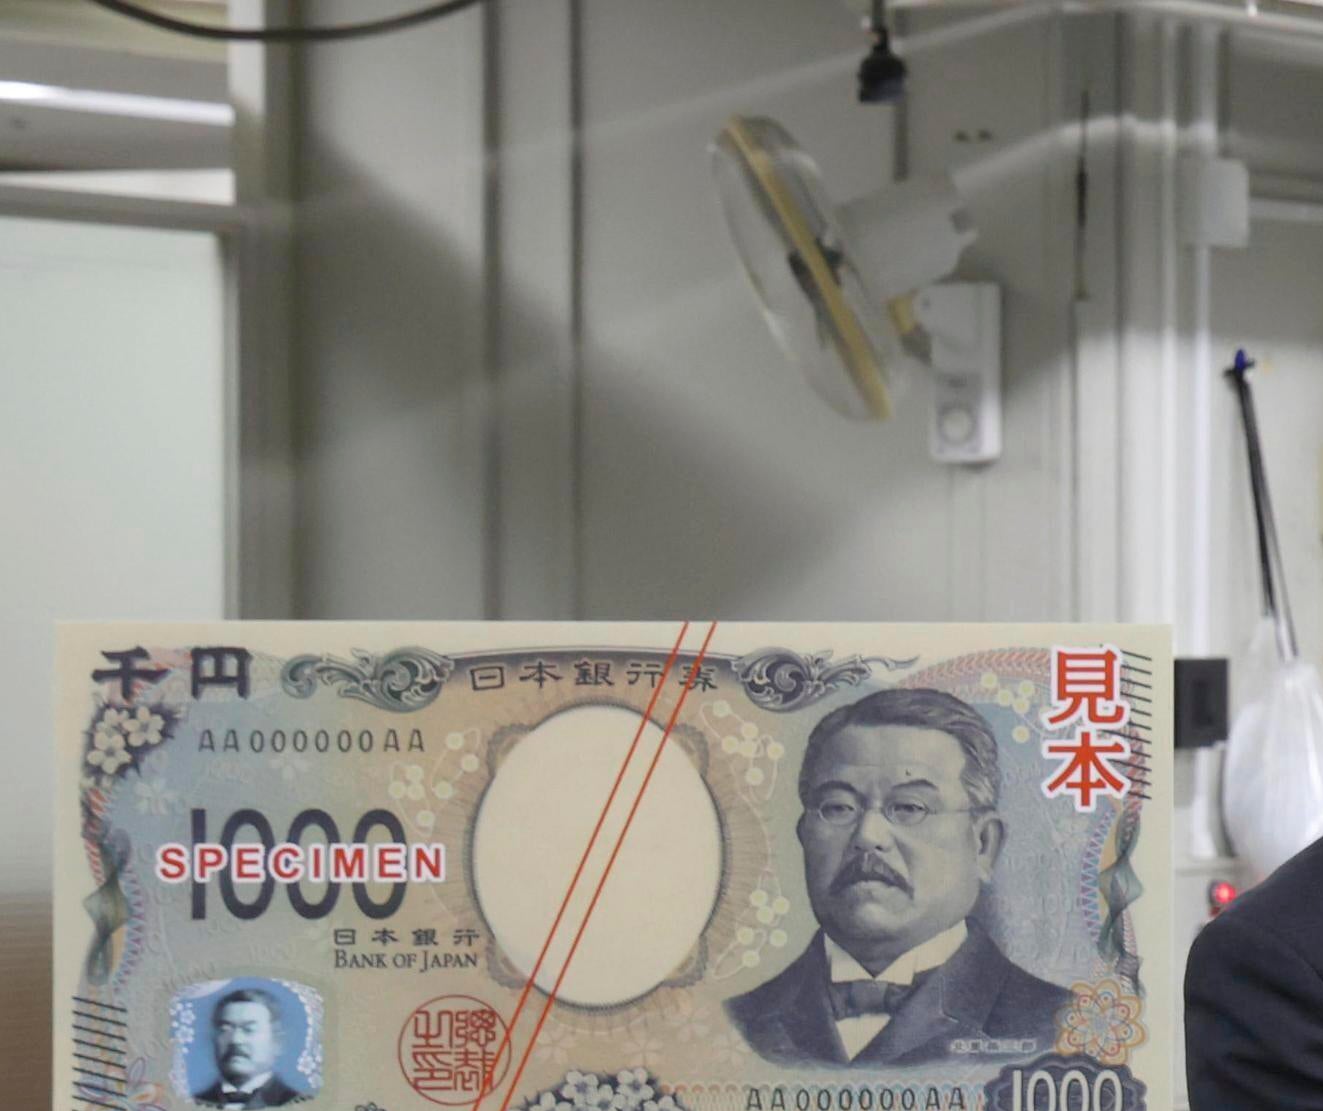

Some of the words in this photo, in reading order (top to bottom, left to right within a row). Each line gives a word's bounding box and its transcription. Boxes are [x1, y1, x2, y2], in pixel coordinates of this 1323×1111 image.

[92, 646, 252, 700] 千円
[198, 728, 426, 753] AA000000AA
[1045, 648, 1129, 809] 見本
[156, 844, 446, 881] SPECIMEN
[190, 808, 408, 921] 1000
[334, 929, 480, 947] 日本銀行
[746, 1087, 966, 1111] AA000000AA
